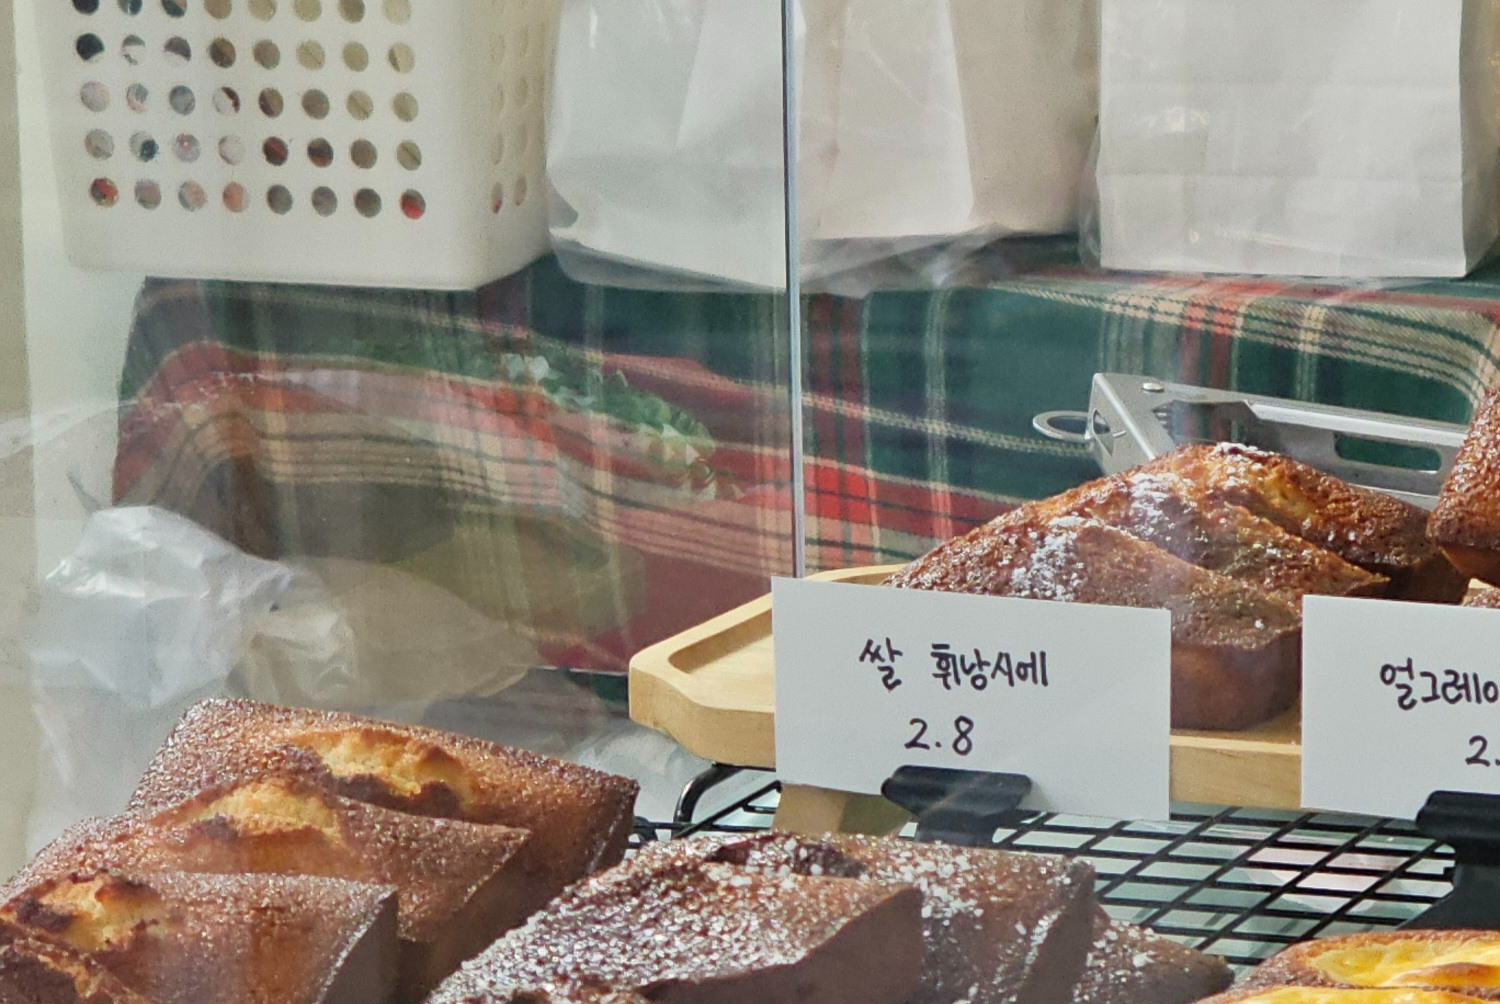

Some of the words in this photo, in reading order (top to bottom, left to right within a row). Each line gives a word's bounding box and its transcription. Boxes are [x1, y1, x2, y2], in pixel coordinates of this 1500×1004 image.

[858, 636, 904, 692] 쌀
[929, 642, 1049, 692] 휘낭시에
[903, 714, 975, 757] 2.8
